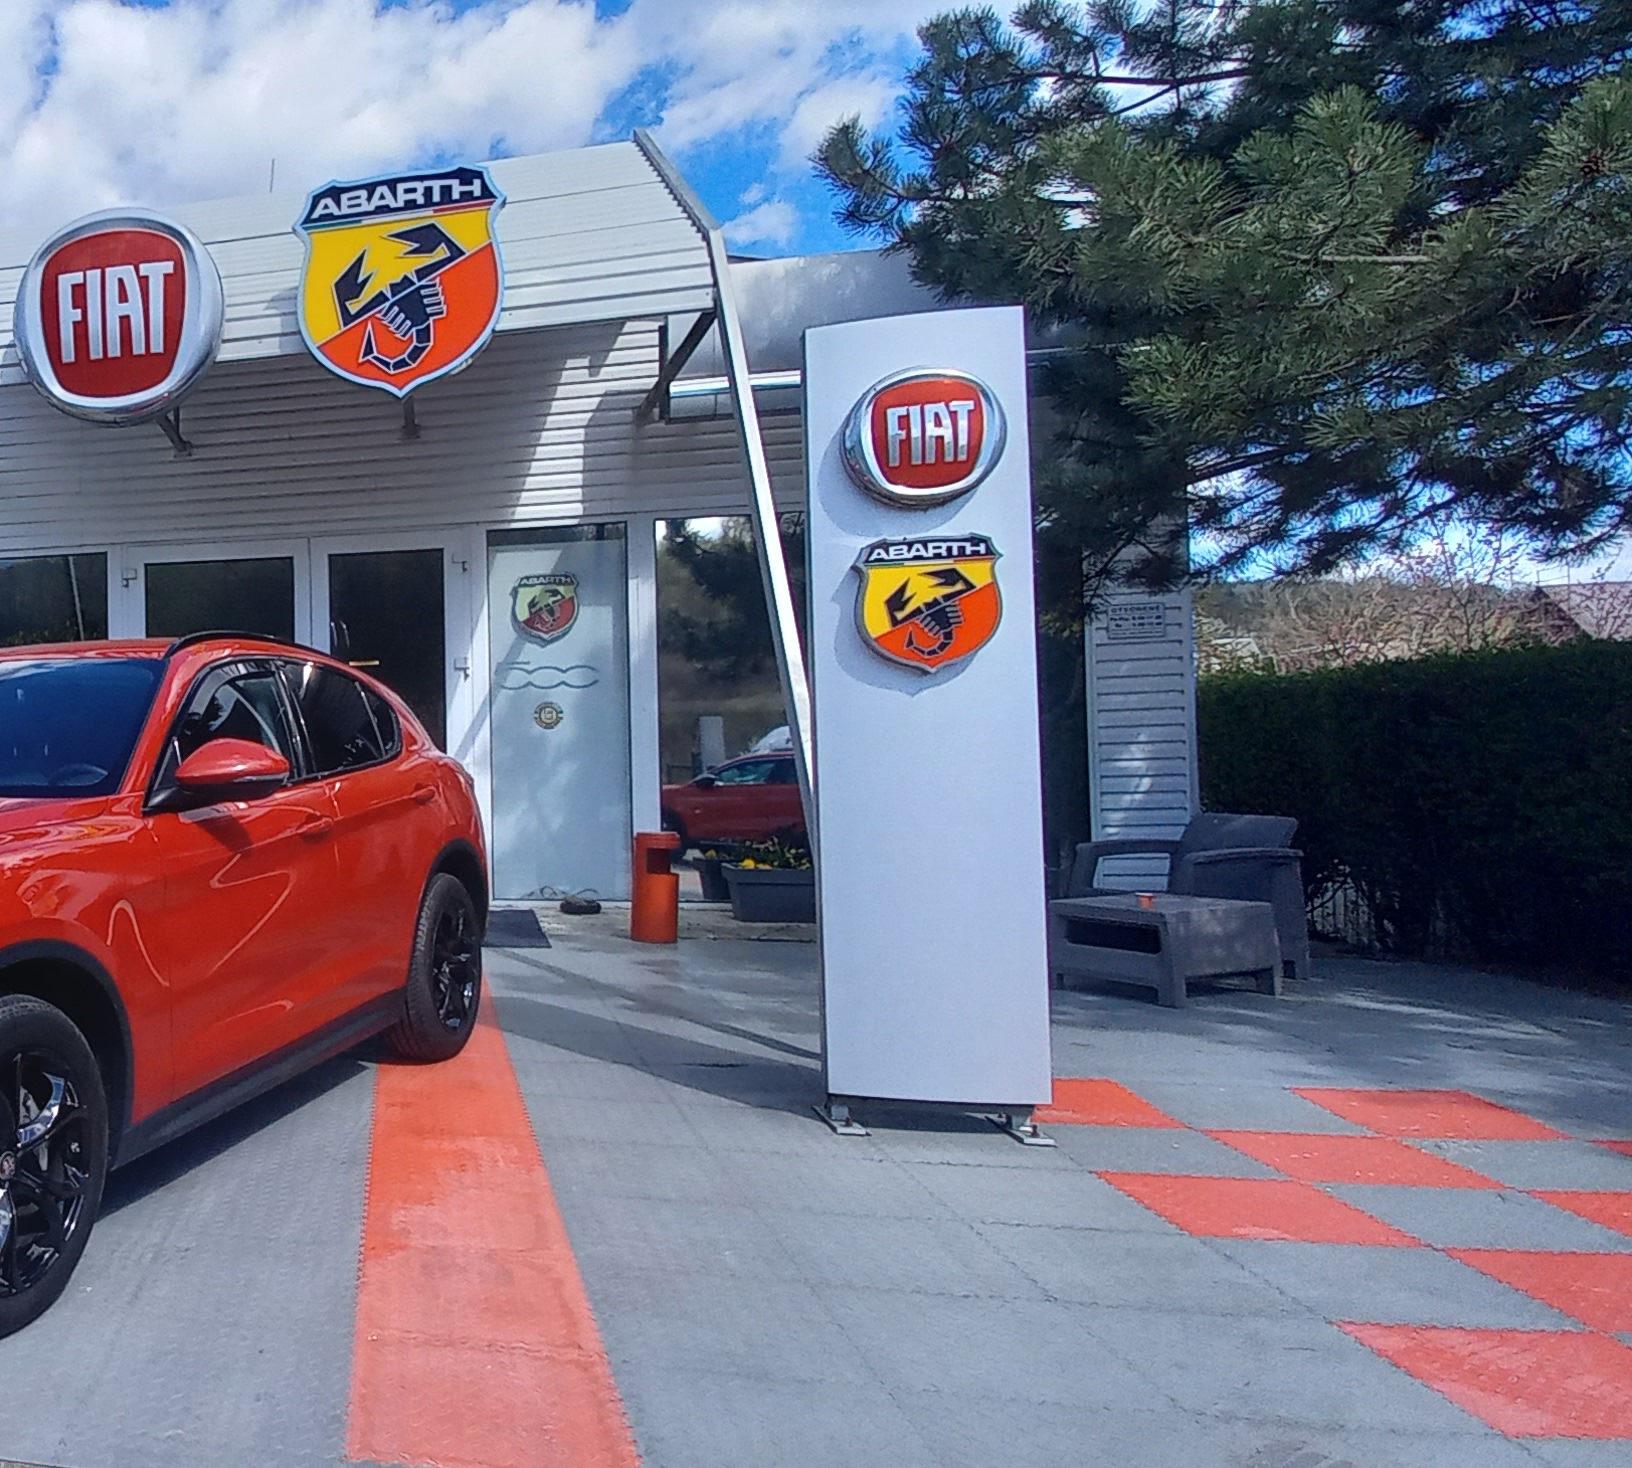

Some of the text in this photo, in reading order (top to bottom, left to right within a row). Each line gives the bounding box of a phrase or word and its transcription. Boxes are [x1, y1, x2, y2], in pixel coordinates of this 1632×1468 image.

[311, 177, 483, 219] ABARTH
[57, 260, 175, 364] FIAT
[886, 400, 975, 468] FIAT
[868, 541, 987, 562] ABARTH
[520, 576, 572, 585] ABARTH
